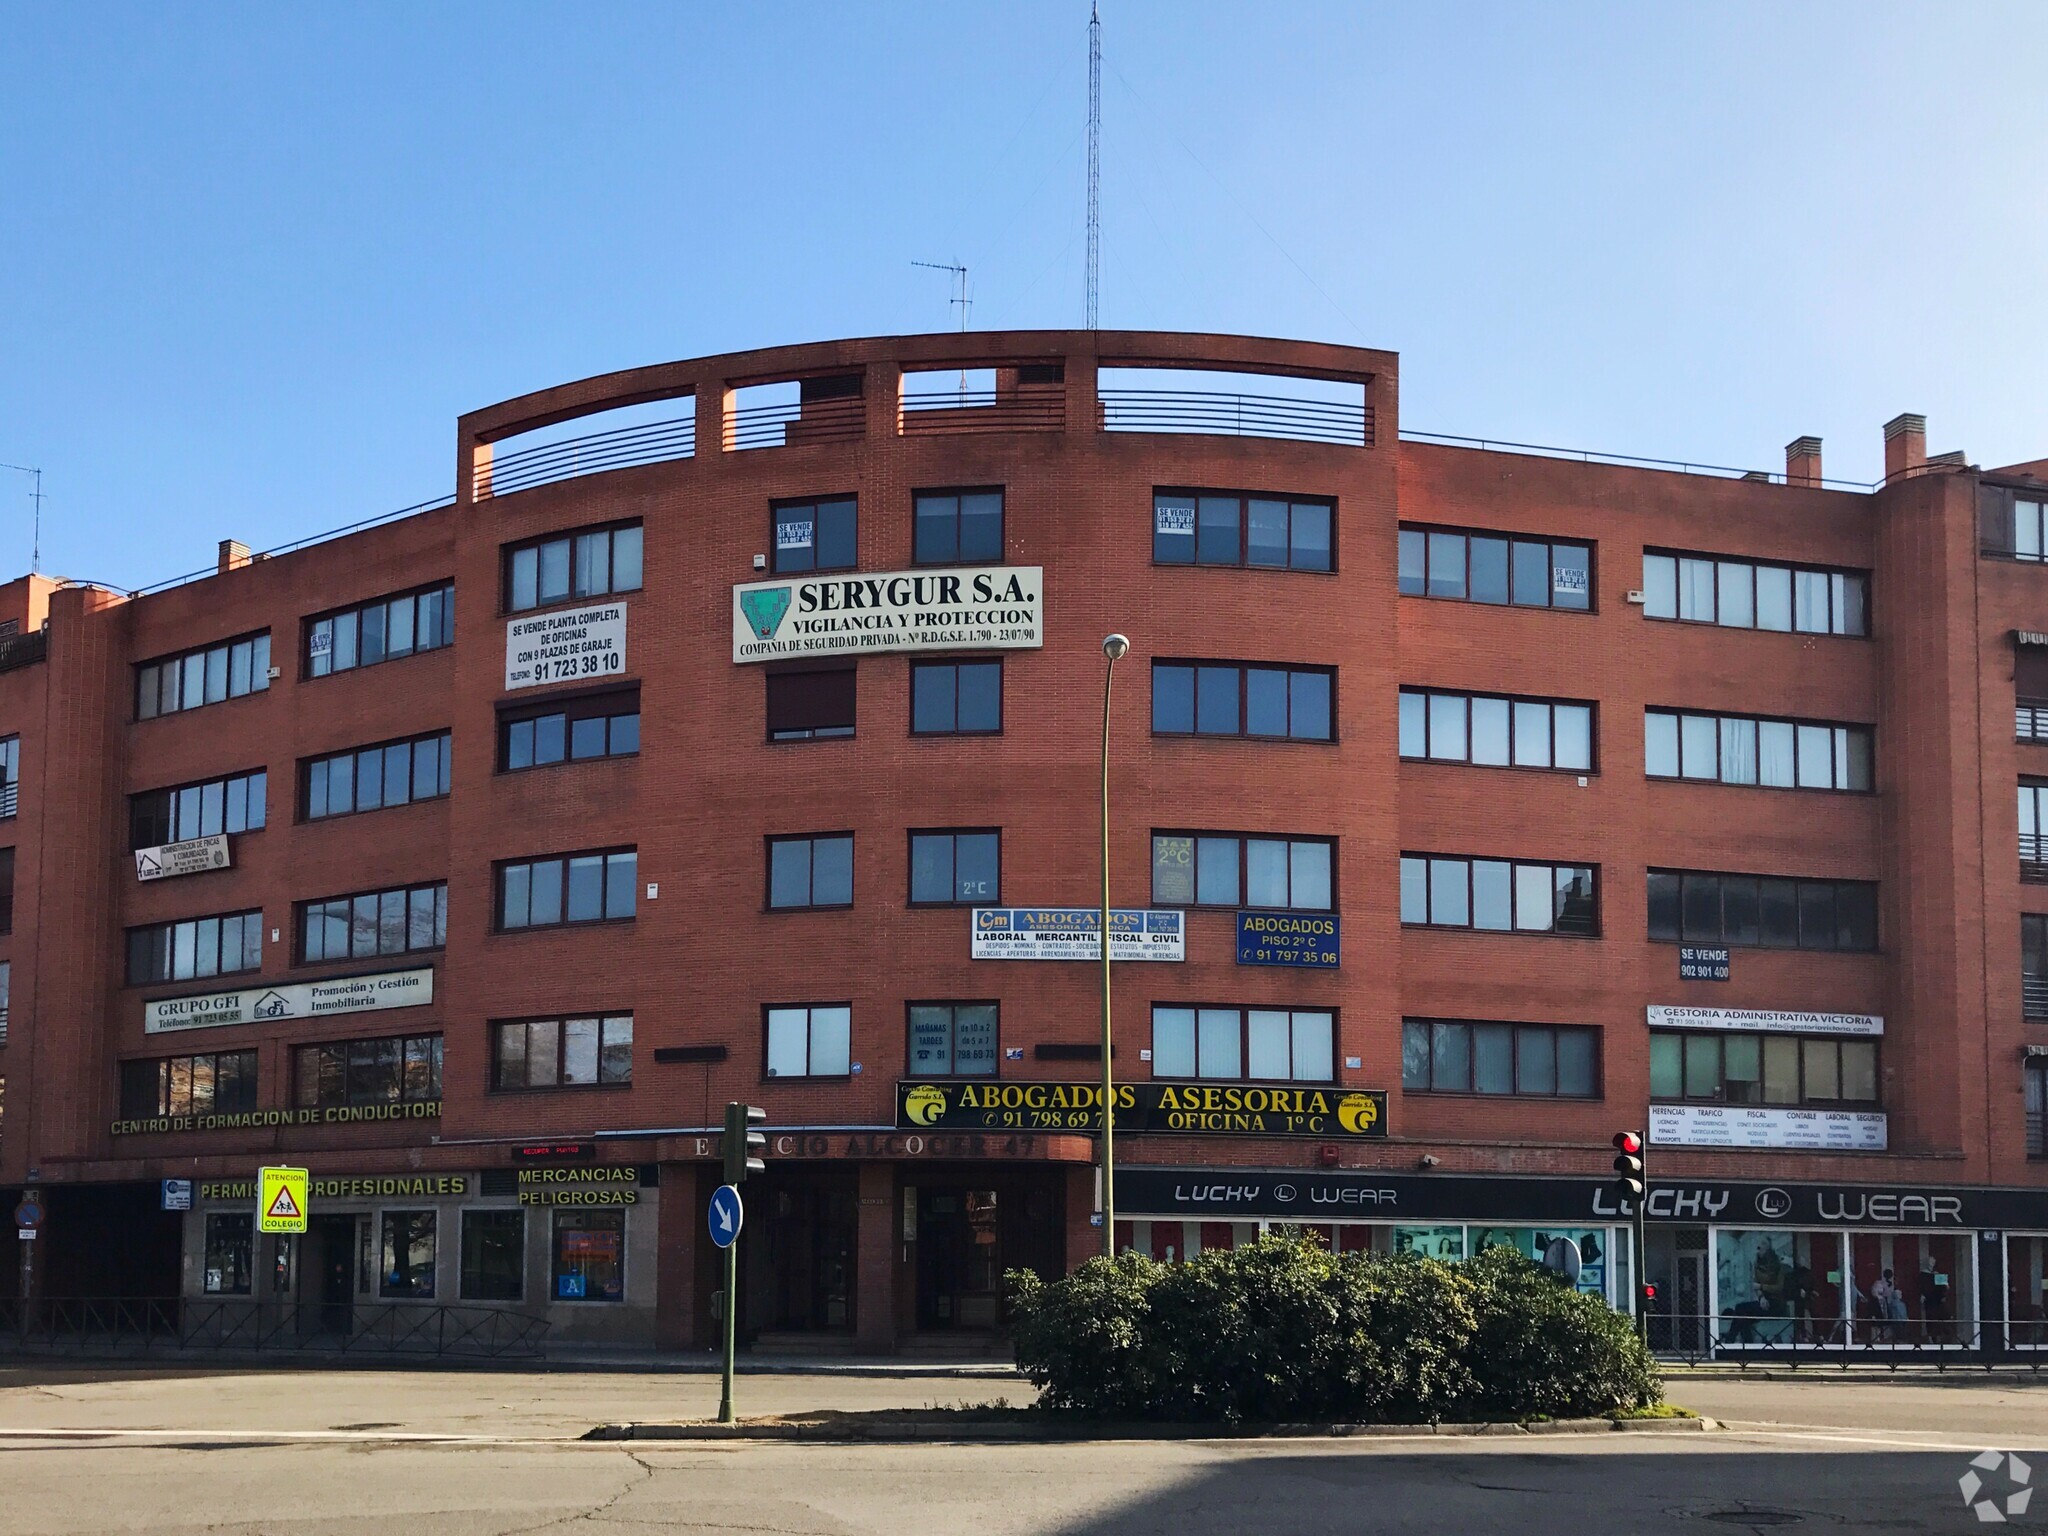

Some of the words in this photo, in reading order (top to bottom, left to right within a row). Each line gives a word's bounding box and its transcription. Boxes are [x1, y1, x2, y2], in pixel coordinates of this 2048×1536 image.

[1170, 509, 1193, 517] VENDE
[779, 524, 788, 532] SE
[789, 523, 810, 531] VENDE
[1565, 570, 1584, 578] VENDE
[799, 576, 963, 613] SERYGUR
[973, 573, 1035, 604] S.A.
[513, 625, 522, 636] SE
[523, 622, 547, 634] VENDE
[548, 616, 577, 630] PLANTA
[578, 609, 619, 625] COMPLETA
[793, 614, 893, 634] VIGILANCIA
[898, 613, 909, 628] Y
[914, 609, 1034, 627] PROTECCION
[541, 634, 551, 645] DE
[552, 628, 587, 643] OFICINAS
[789, 640, 801, 652] DE
[803, 636, 858, 650] SEGURIDAD
[861, 633, 900, 646] PRIVADA
[921, 631, 967, 643] R.D.G.S.E.
[969, 630, 991, 642] 1.790
[999, 629, 1035, 641] 23/07/90
[517, 651, 533, 663] CON
[534, 650, 539, 660] 9
[540, 645, 568, 659] PLAZAS
[570, 643, 580, 654] DE
[581, 638, 612, 652] GARAJE
[535, 663, 549, 681] 91
[554, 658, 578, 678] 723
[581, 655, 598, 674] 38
[602, 652, 619, 671] 10
[1244, 918, 1334, 935] ABOGADOS
[976, 933, 1026, 941] LABORAL
[1035, 933, 1097, 942] MERCANTIL
[1152, 935, 1180, 943] CIVIL
[1262, 936, 1290, 946] PISO
[1293, 936, 1305, 946] 2º
[1308, 937, 1316, 947] C
[1256, 949, 1271, 960] 91
[1276, 950, 1299, 961] 797
[1303, 951, 1318, 962] 35
[1321, 952, 1337, 963] 06
[1681, 948, 1694, 959] SE
[1696, 949, 1728, 960] VENDE
[1681, 965, 1696, 977] 902
[1697, 966, 1712, 977] 901
[1714, 966, 1729, 978] 400
[312, 982, 367, 997] Promoción
[369, 983, 376, 993] y
[378, 976, 419, 990] Gestión
[158, 999, 210, 1016] GRUPO
[213, 996, 240, 1008] GFI
[311, 996, 376, 1011] Inmobiliaria
[193, 1014, 201, 1024] 91
[204, 1013, 217, 1023] 723
[218, 1012, 228, 1022] 05
[229, 1011, 239, 1021] 55
[1663, 1008, 1720, 1018] GESTORIA
[1724, 1011, 1818, 1023] ADMINISTRATIVA
[1820, 1015, 1873, 1025] VICTORIA
[915, 1023, 946, 1033] MAÑANAS
[960, 1024, 969, 1033] de
[971, 1024, 978, 1032] 10
[986, 1023, 990, 1032] 2
[919, 1036, 943, 1045] TARDES
[937, 1050, 945, 1059] 91
[957, 1050, 971, 1060] 798
[985, 1049, 994, 1059] 73
[959, 1085, 1136, 1109] ABOGADOS
[1158, 1086, 1330, 1114] ASESORIA
[1003, 1111, 1024, 1127] 91
[1030, 1111, 1062, 1128] 798
[1067, 1111, 1089, 1128] 69
[1652, 1108, 1685, 1116] HERENCIAS
[1697, 1109, 1723, 1117] TRAFICO
[1747, 1111, 1766, 1119] FISCAL
[1786, 1112, 1817, 1120] CONTABLE
[1825, 1113, 1851, 1121] LABORAL
[1856, 1114, 1884, 1122] SEGUROS
[111, 1118, 169, 1135] CENTRO
[173, 1117, 193, 1131] DE
[198, 1110, 293, 1129] FORMACION
[300, 1109, 320, 1124] DE
[1168, 1112, 1265, 1131] OFICINA
[1309, 1116, 1324, 1133] C
[846, 1135, 985, 1155] ALCOCER
[266, 1174, 304, 1182] ATENCION
[518, 1167, 635, 1183] MERCANCIAS
[519, 1190, 636, 1205] PELIGROSAS
[1175, 1185, 1260, 1201] LUCKY
[1311, 1187, 1397, 1204] WEAR
[1817, 1192, 1963, 1223] WEAR
[265, 1220, 303, 1228] COLEGIO
